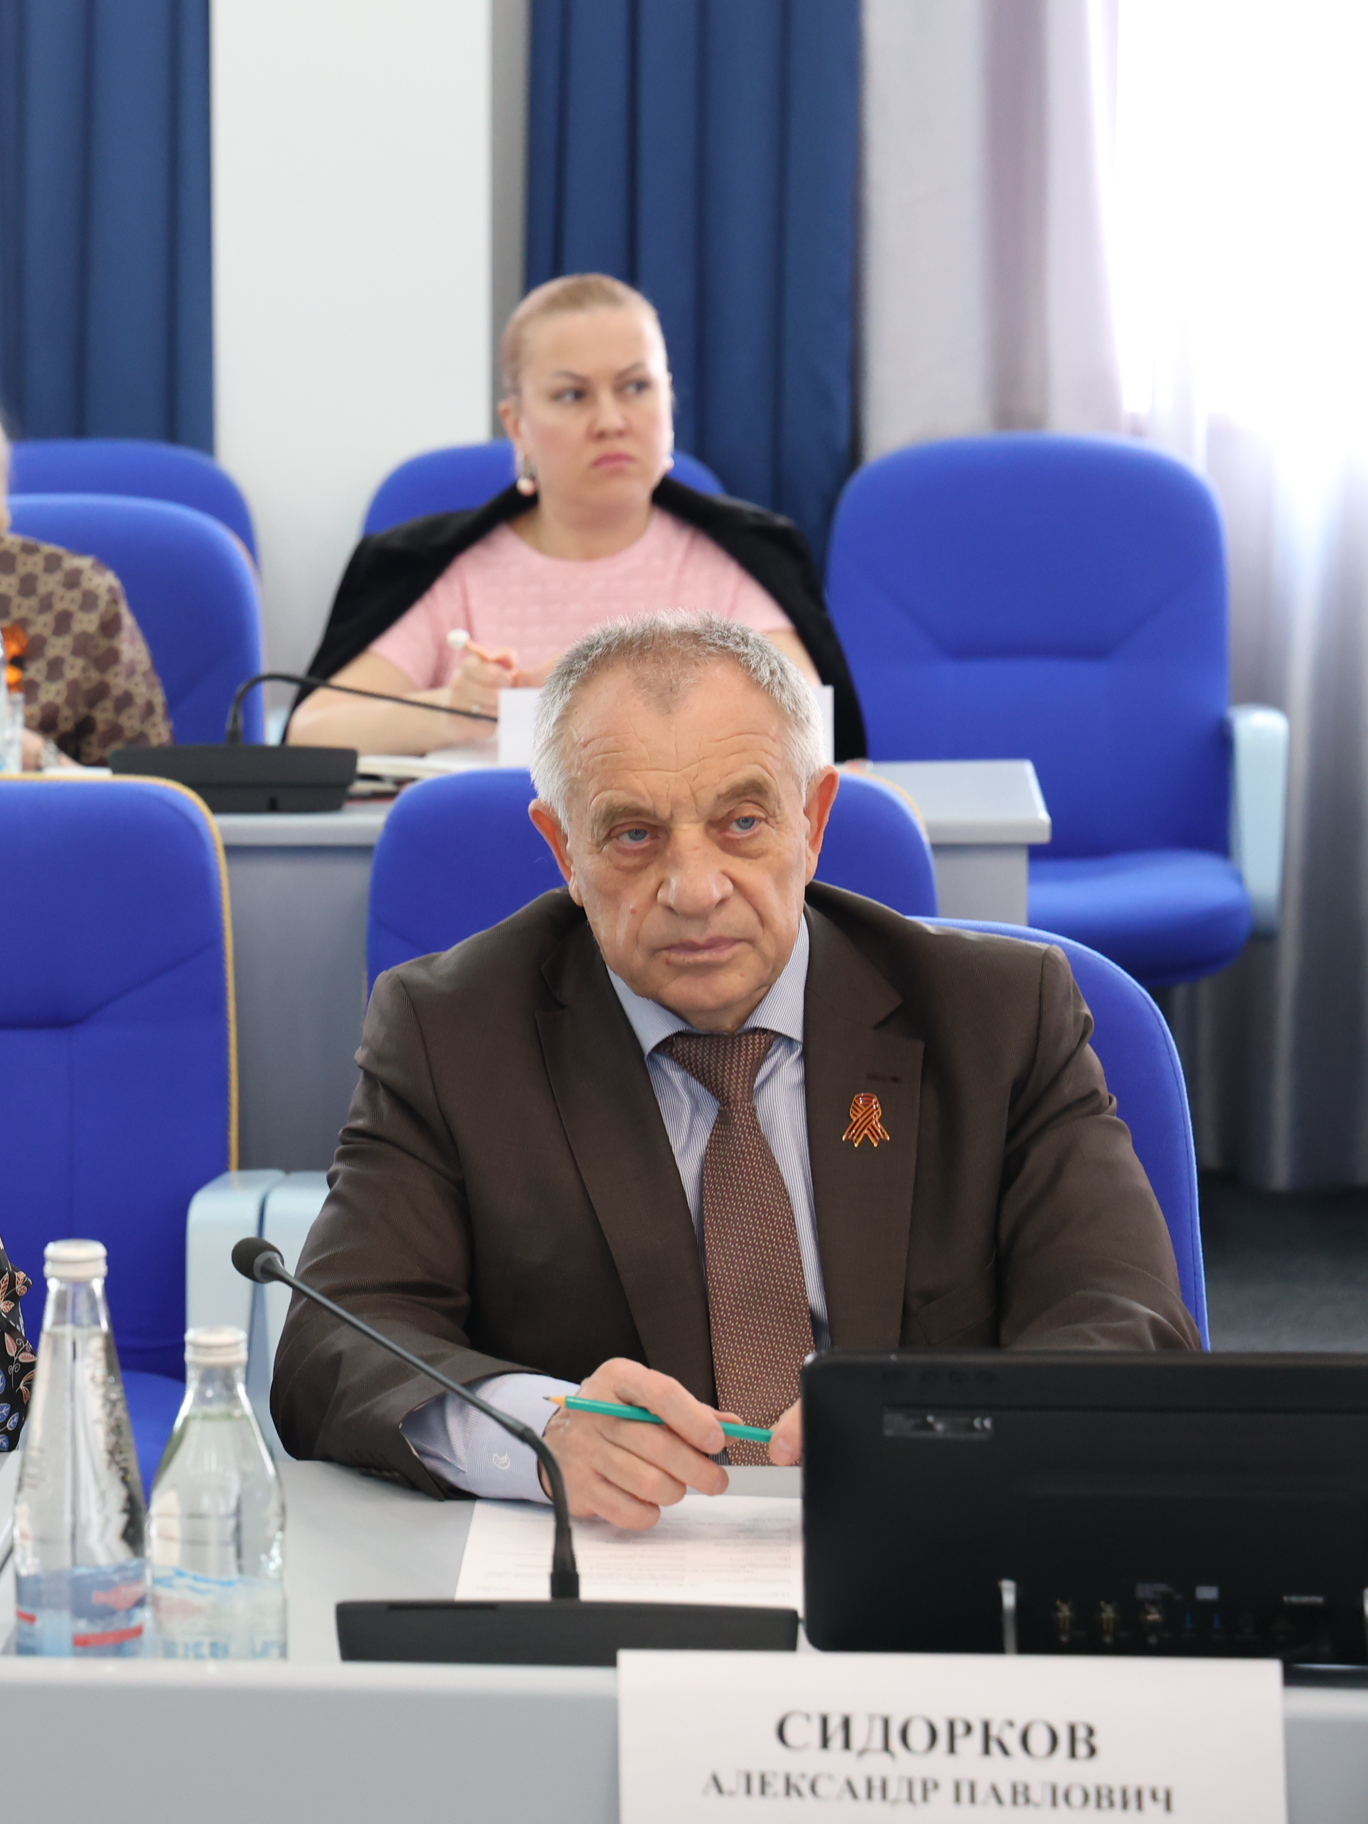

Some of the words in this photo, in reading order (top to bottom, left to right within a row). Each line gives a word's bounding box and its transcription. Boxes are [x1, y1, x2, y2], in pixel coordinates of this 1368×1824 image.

[774, 1709, 1100, 1762] СИДОРКОВ
[702, 1770, 942, 1808] АЛЕКСАНДР
[950, 1776, 1176, 1815] ПАВЛОВИЧ
